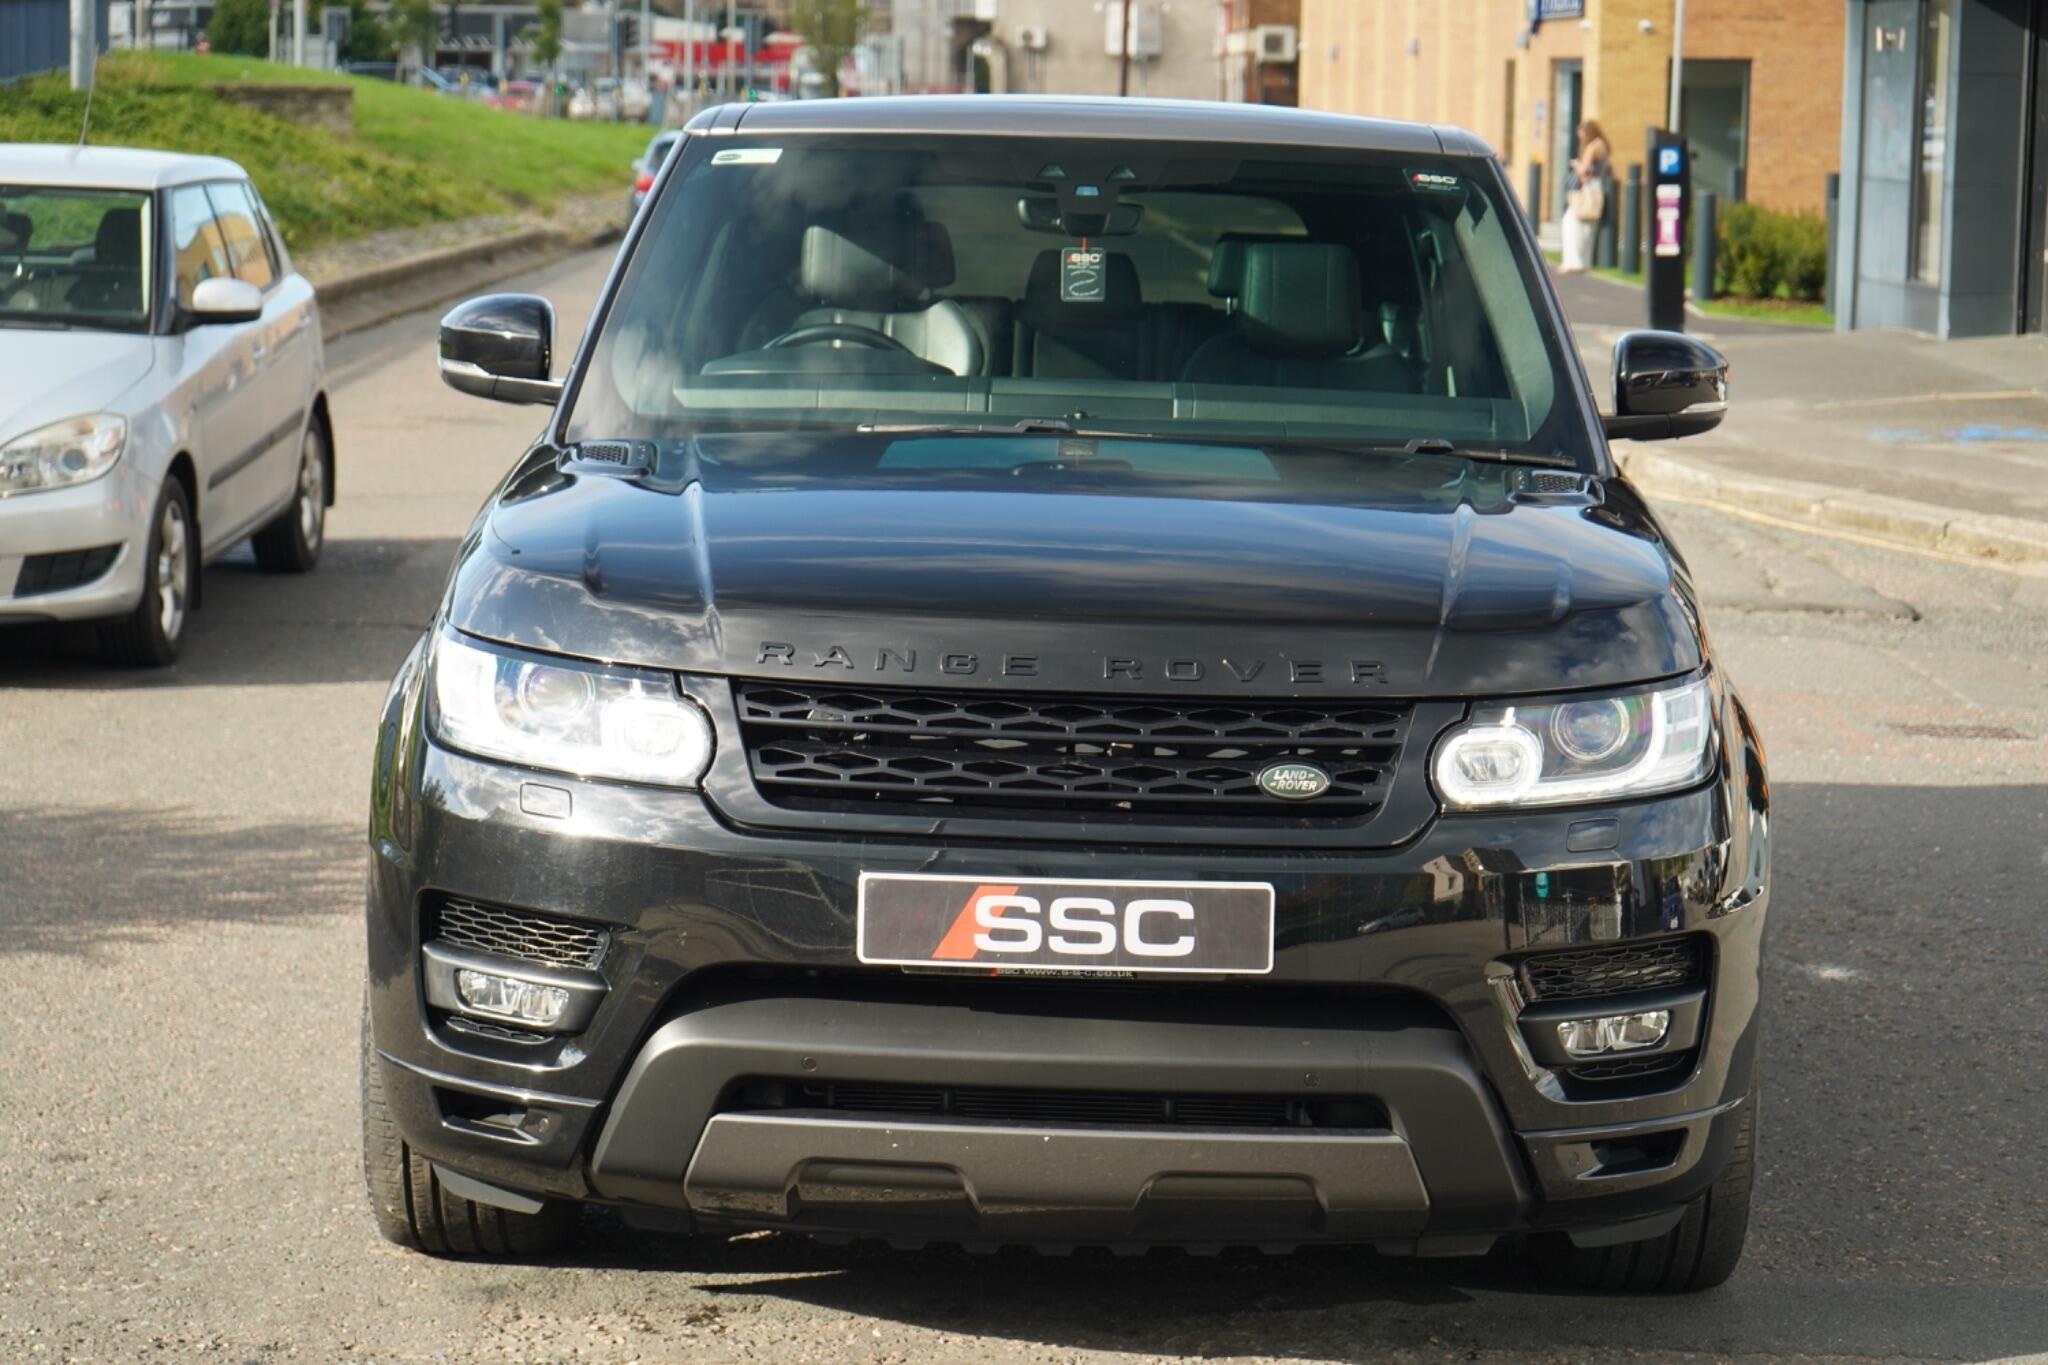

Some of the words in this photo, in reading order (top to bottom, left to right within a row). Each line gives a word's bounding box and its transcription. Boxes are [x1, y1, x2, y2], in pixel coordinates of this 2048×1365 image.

[1660, 149, 1679, 173] P
[757, 641, 1039, 677] RANGE
[1103, 656, 1391, 684] ROVER
[973, 894, 1195, 957] SSC
